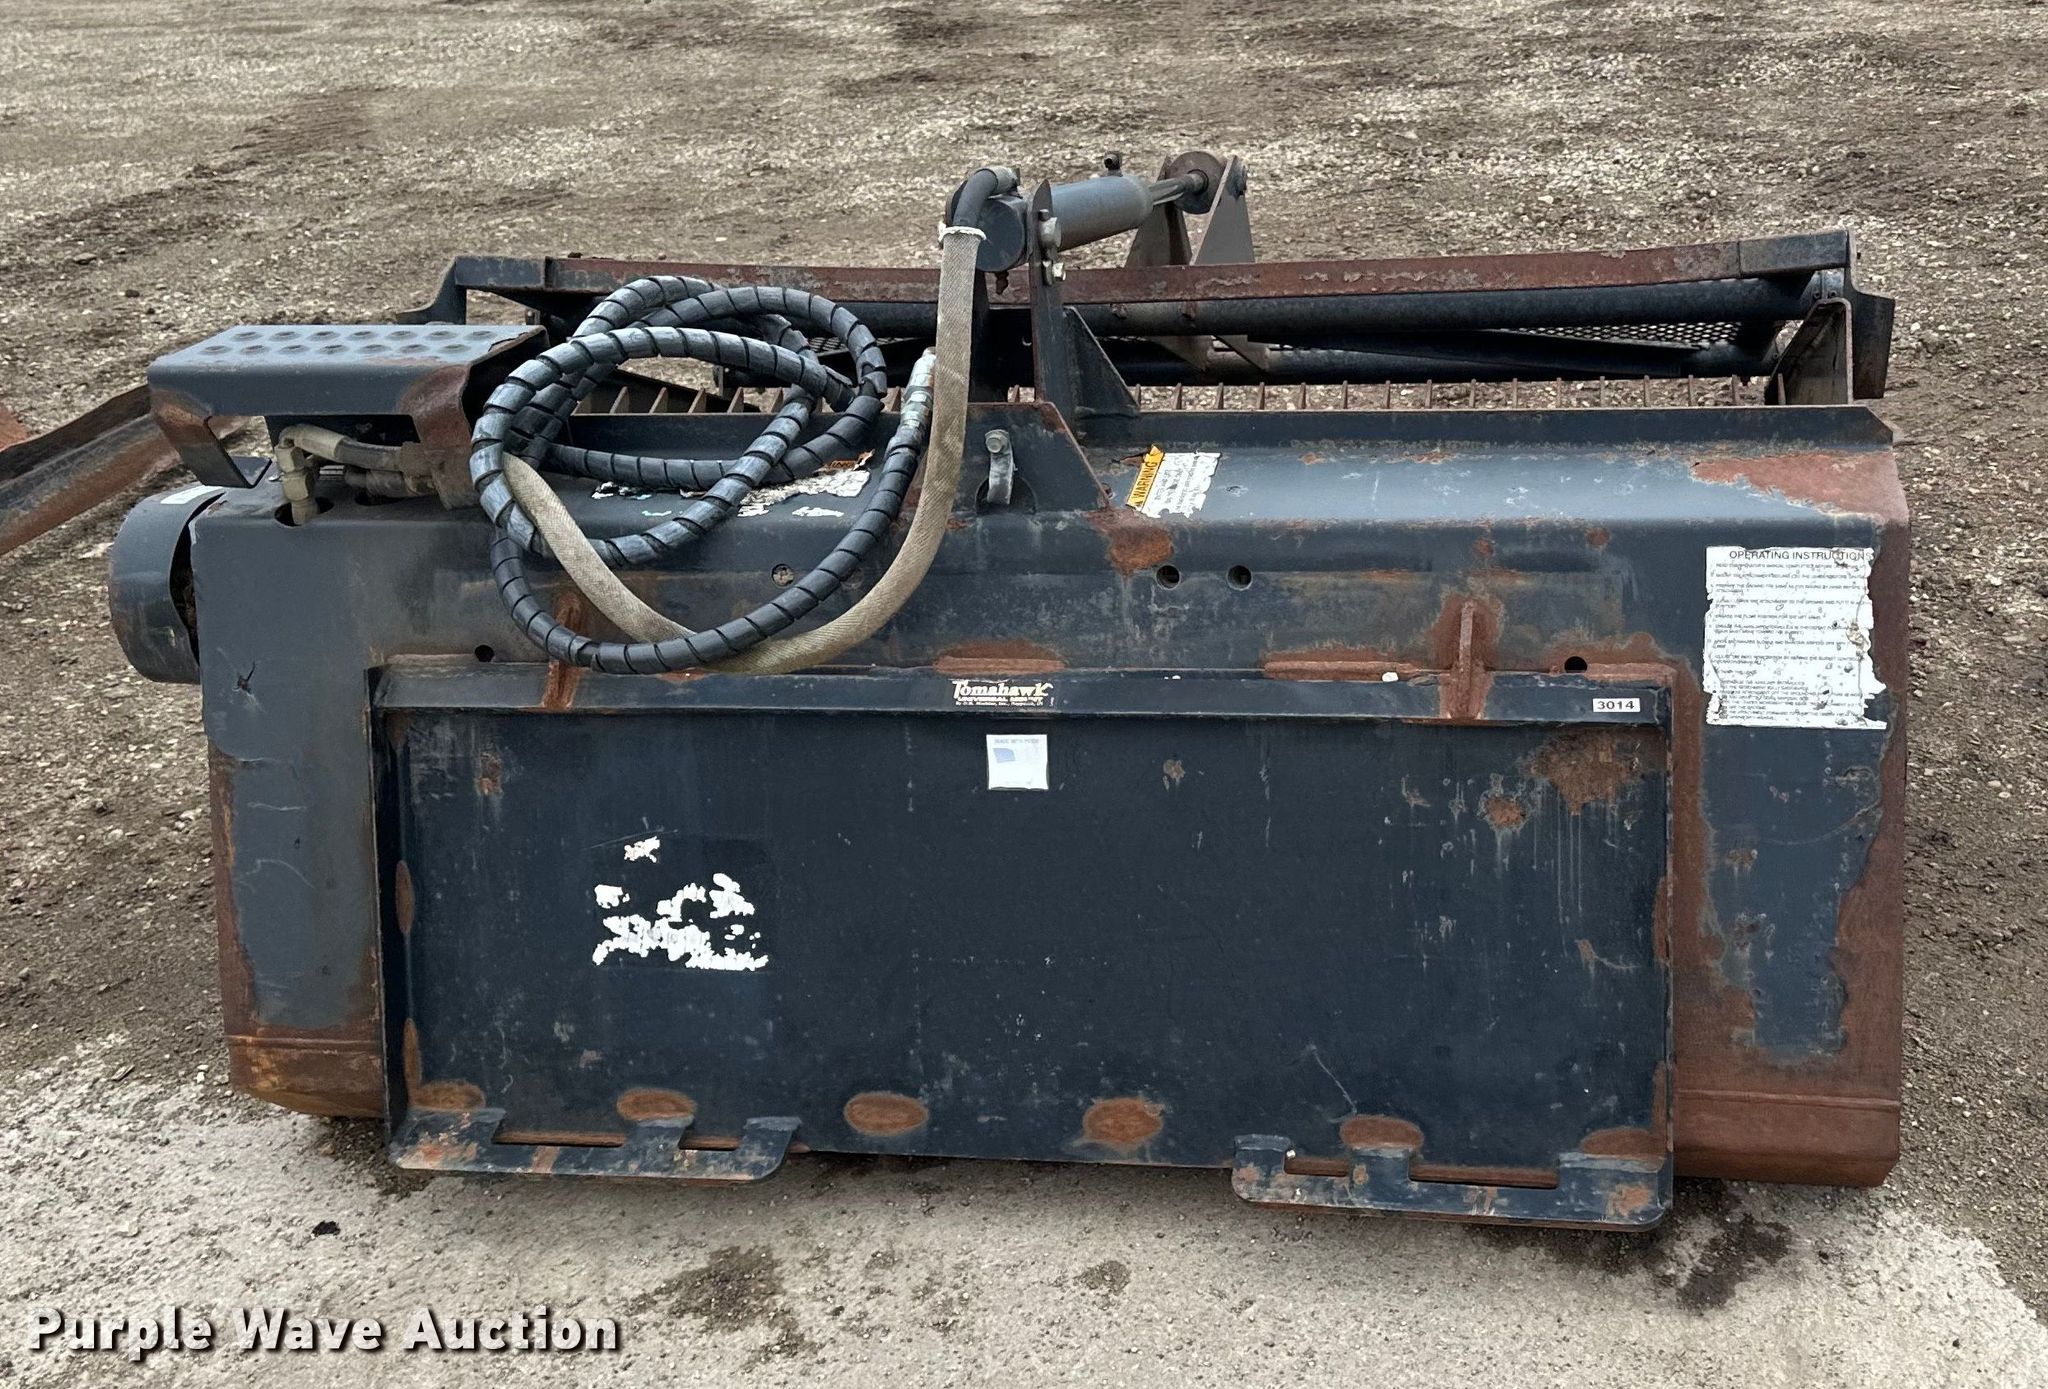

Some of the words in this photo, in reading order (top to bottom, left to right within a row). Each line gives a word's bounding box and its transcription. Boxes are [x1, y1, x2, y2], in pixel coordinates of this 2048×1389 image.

[1133, 461, 1158, 497] WARNING
[1729, 550, 1790, 560] OPERATING
[1792, 551, 1874, 561] INSTRUCTIONS
[1598, 701, 1635, 710] 3014
